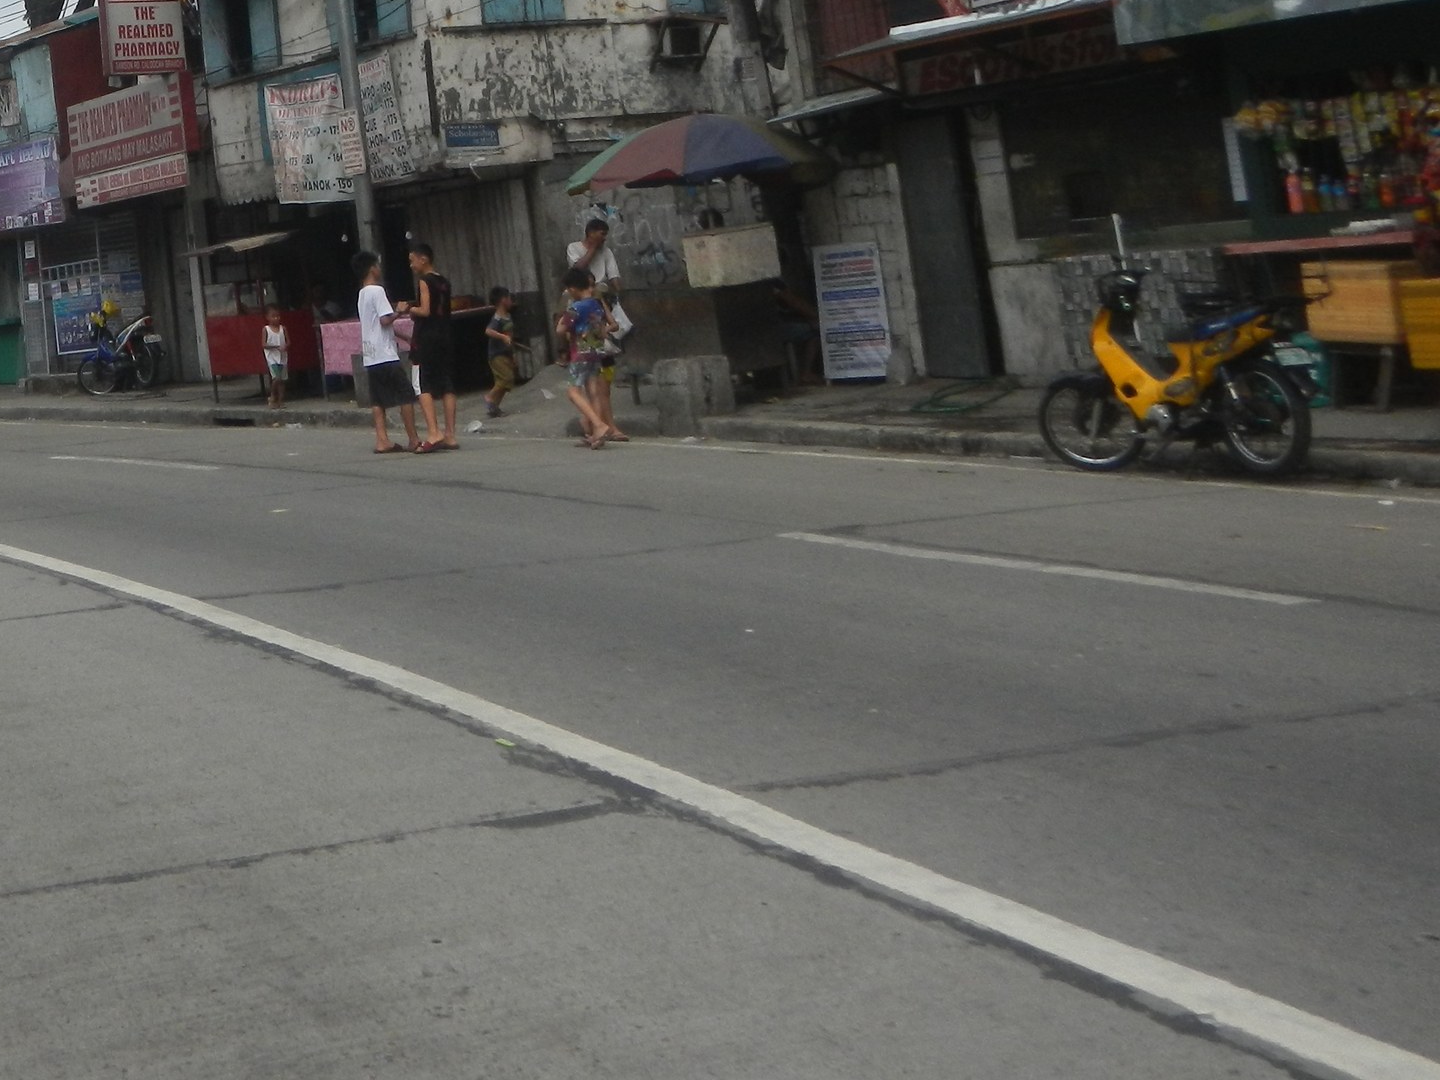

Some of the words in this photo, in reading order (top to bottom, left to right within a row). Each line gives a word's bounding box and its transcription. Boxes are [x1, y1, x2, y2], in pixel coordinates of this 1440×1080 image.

[133, 6, 156, 21] THE
[118, 23, 174, 39] REALMED
[114, 41, 180, 58] PHARMACY
[77, 153, 91, 171] ANG
[91, 143, 122, 169] BOTIKANG
[122, 141, 136, 160] MAY
[338, 178, 353, 189] 150
